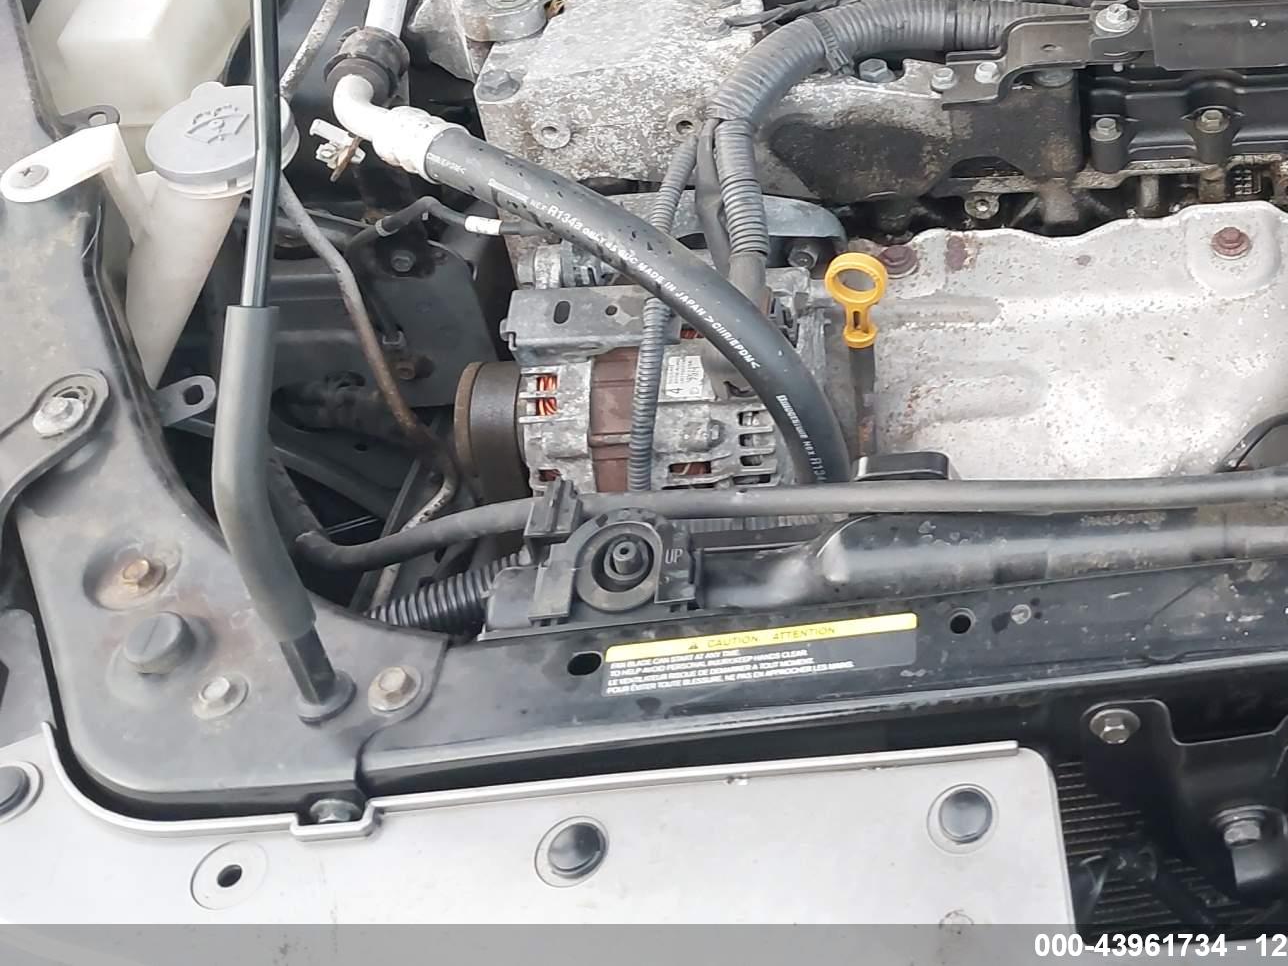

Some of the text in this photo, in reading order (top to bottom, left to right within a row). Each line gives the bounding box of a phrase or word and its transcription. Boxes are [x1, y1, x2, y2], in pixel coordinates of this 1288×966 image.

[547, 205, 584, 230] R134a
[638, 262, 665, 286] MADE
[664, 281, 677, 293] IN
[675, 292, 706, 317] JAPAN
[665, 548, 684, 564] UP
[708, 627, 835, 648] CAUTION ATTENTION
